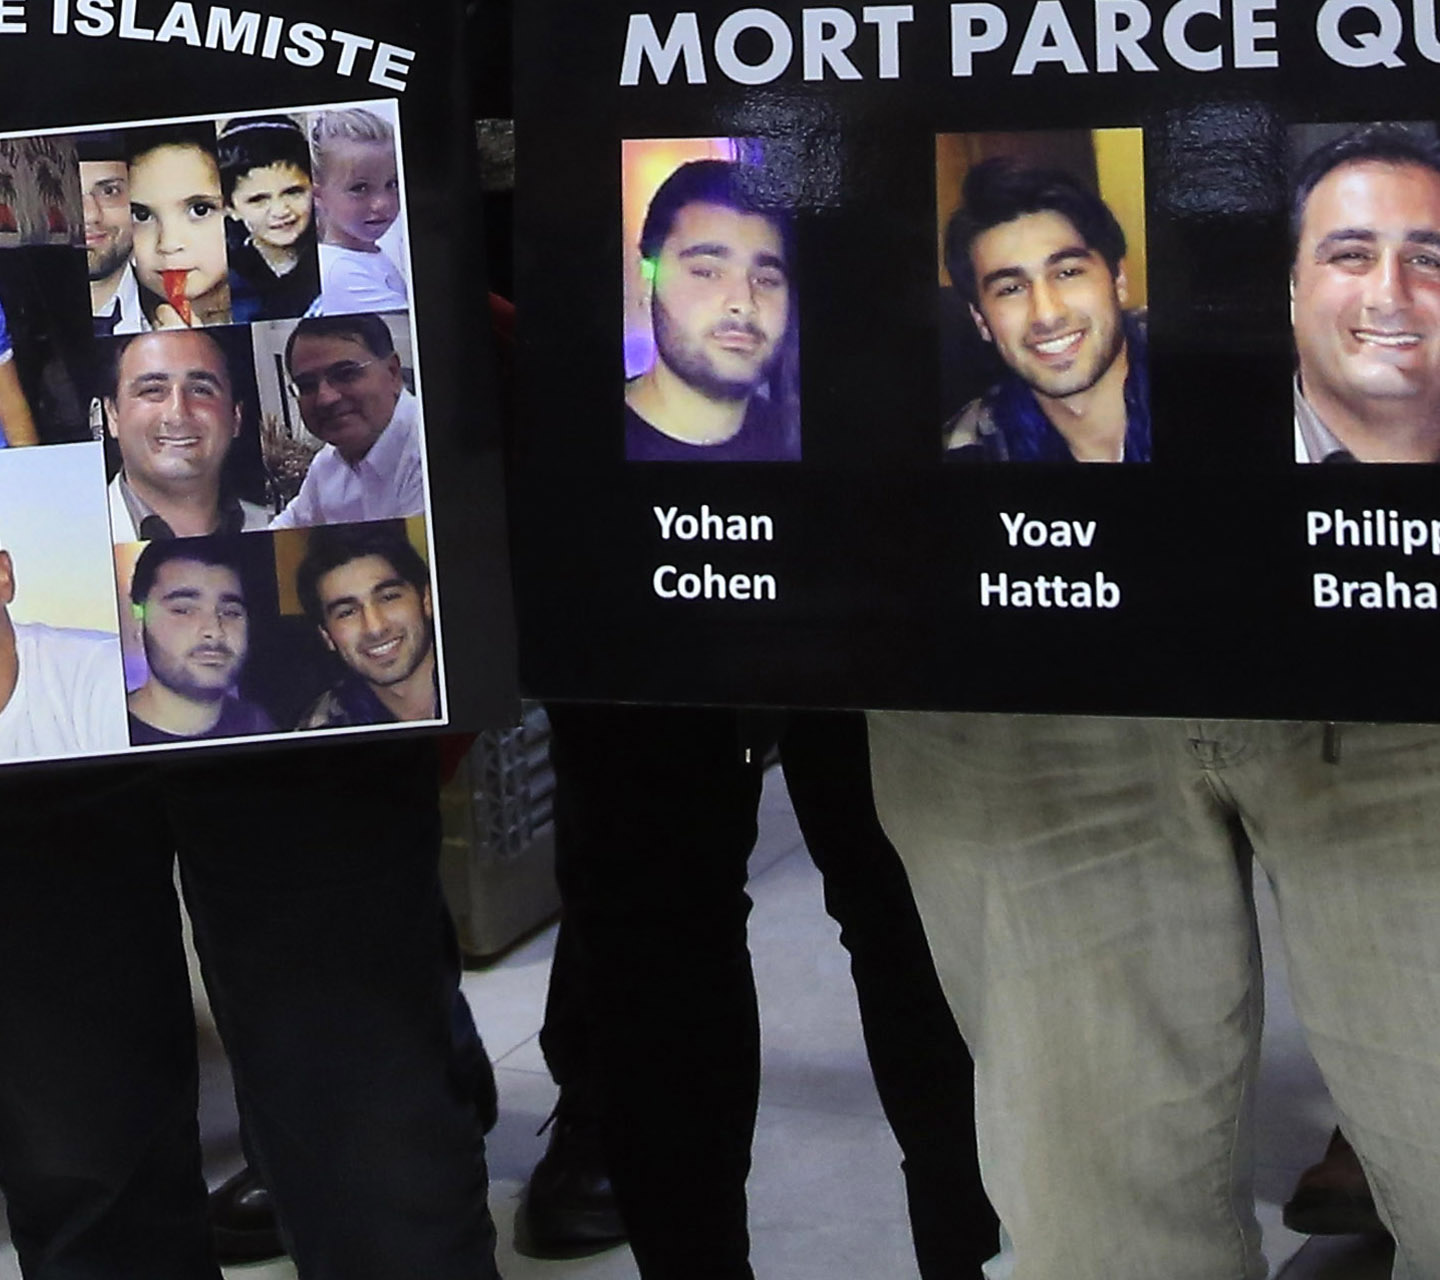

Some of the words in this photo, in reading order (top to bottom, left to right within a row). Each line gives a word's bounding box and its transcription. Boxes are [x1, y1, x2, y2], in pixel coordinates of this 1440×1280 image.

[620, 6, 914, 86] MORT
[654, 505, 772, 540] Yohan
[1000, 513, 1096, 546] Yoav
[654, 564, 776, 599] Cohen
[981, 572, 1120, 608] Hattab
